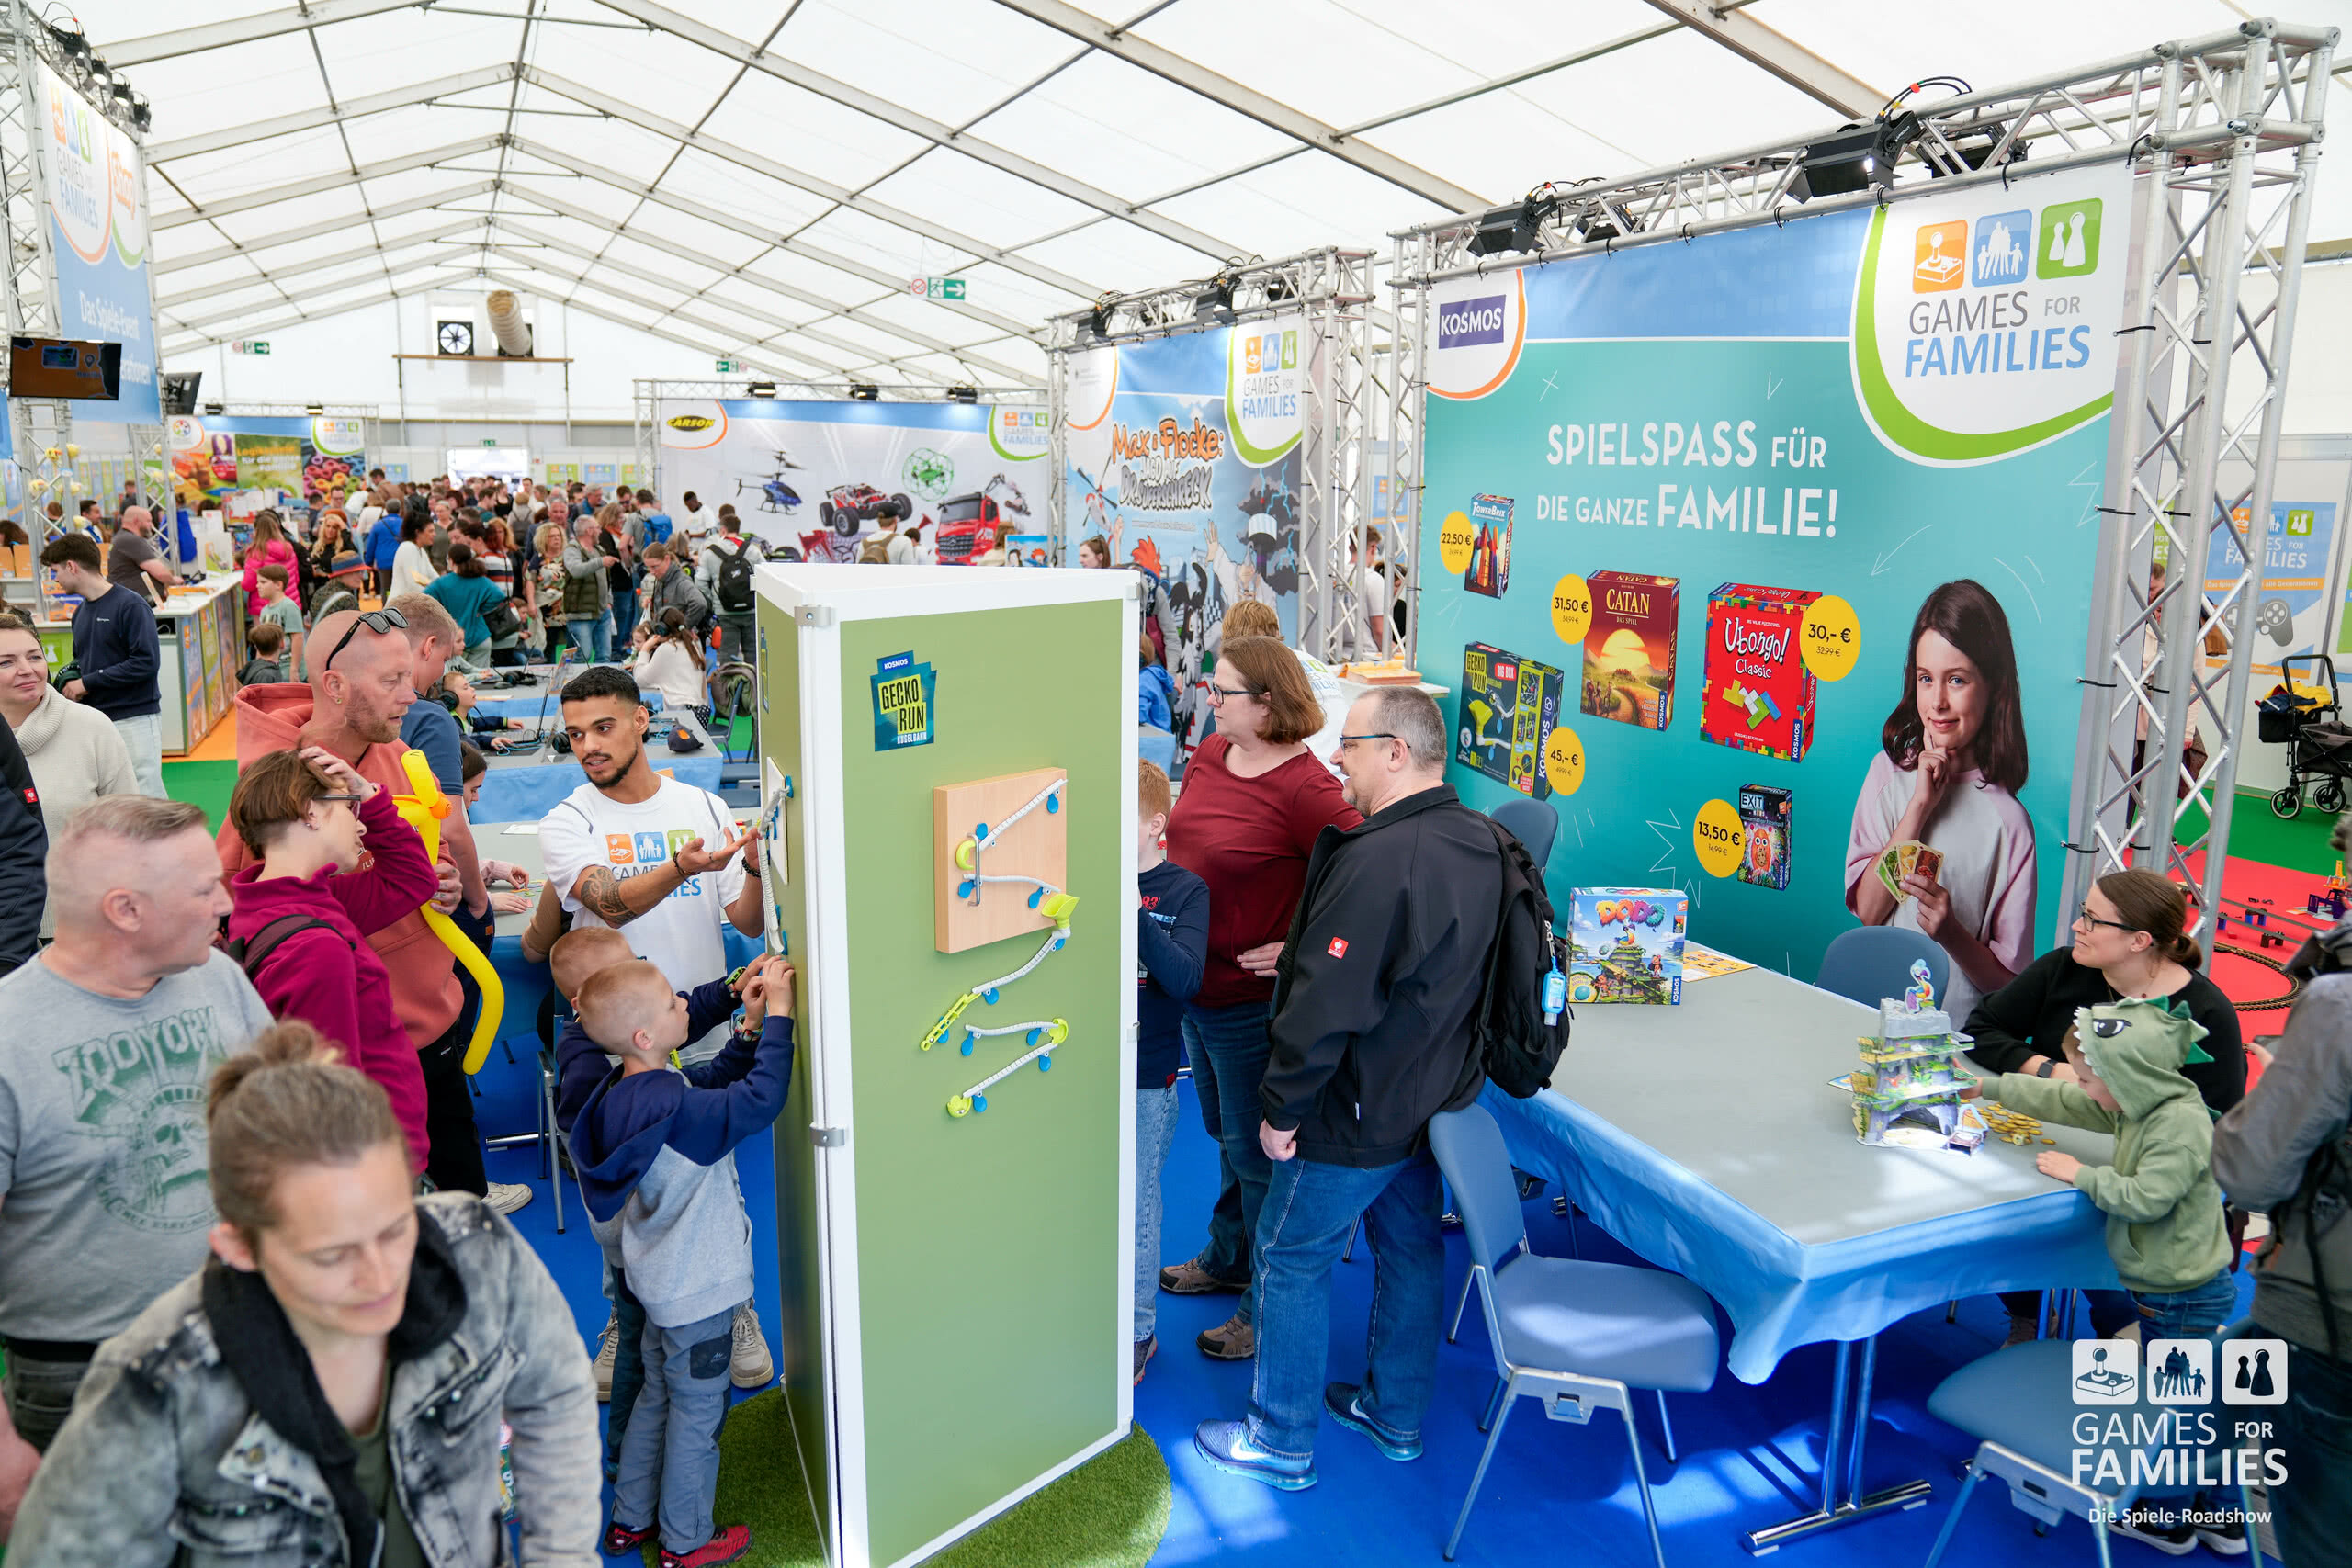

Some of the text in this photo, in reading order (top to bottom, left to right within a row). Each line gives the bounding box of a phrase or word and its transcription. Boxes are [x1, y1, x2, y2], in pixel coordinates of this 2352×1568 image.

[1441, 307, 1502, 336] KOSMOS
[1909, 290, 2081, 335] GAMES FOR
[1905, 324, 2091, 378] FAMILIES
[1244, 375, 1280, 397] GAMES
[1242, 394, 1296, 420] FAMILIES
[667, 418, 715, 427] CARSON
[1112, 423, 1150, 464] Max
[1546, 420, 1826, 468] SPIELSPASS FÜR
[1537, 484, 1838, 538] DIE GANZE FAMILIE!
[1442, 533, 1472, 546] 22,50 €
[2227, 536, 2304, 551] GAES FOR
[2224, 549, 2309, 569] FAILIES
[1555, 597, 1589, 613] 31,50 €
[1606, 588, 1650, 615] CATAN
[1724, 617, 1791, 663] Ubongo!
[1808, 624, 1851, 643] 30,- €
[884, 658, 909, 670] KOSMOS
[1466, 653, 1486, 672] GECKO
[1505, 666, 1514, 679] BOX
[1736, 659, 1773, 679] Classic
[881, 678, 920, 710] GECKO
[1473, 672, 1487, 694] RUN
[899, 705, 924, 732] RUN
[897, 732, 927, 745] KUGELBAHN
[1538, 719, 1551, 779] KOSMOS
[1792, 723, 1801, 758] KOSMOS
[1551, 750, 1578, 766] 45,- €
[1742, 794, 1763, 808] EXIT
[1699, 821, 1728, 842] 13,50
[1732, 832, 1740, 846] €
[1596, 899, 1667, 928] DODO
[1673, 977, 1681, 1003] KOSMOS
